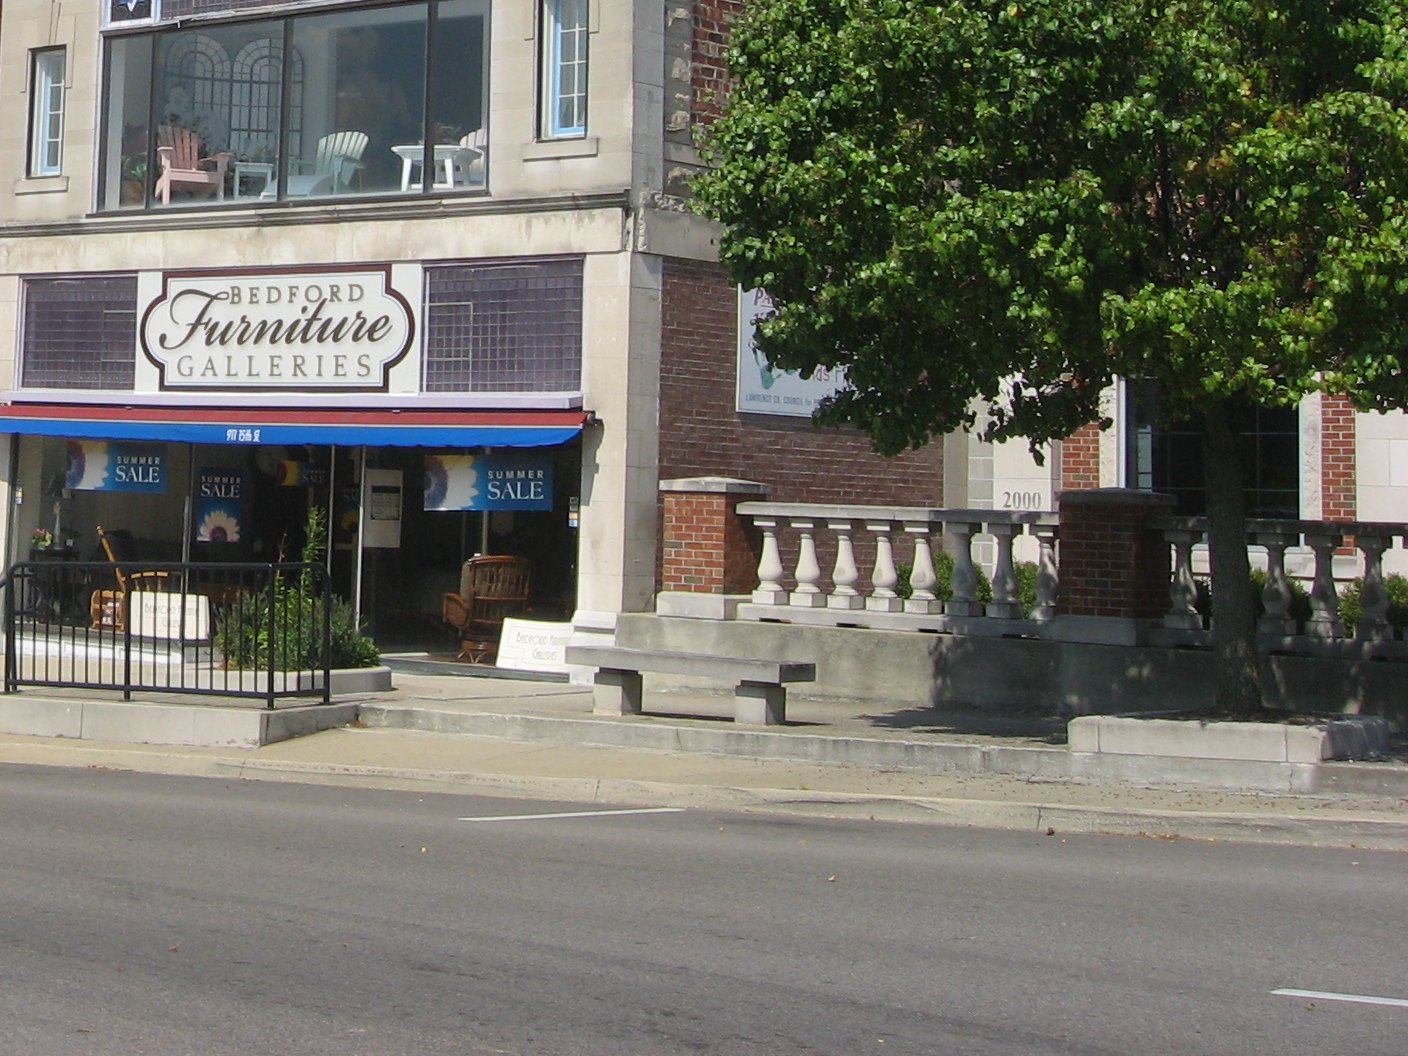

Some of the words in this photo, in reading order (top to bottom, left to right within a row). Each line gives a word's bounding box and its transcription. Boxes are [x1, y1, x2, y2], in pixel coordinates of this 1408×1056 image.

[229, 283, 365, 305] BEDFORD
[158, 288, 393, 351] Furniture
[176, 354, 371, 378] GALLERIES
[117, 456, 160, 465] SUMMER
[115, 465, 160, 483] SALE
[201, 475, 241, 484] SUMMER
[487, 470, 544, 479] SUMMER
[200, 484, 240, 498] SALE
[487, 481, 544, 500] SALE
[1002, 491, 1042, 510] 2000
